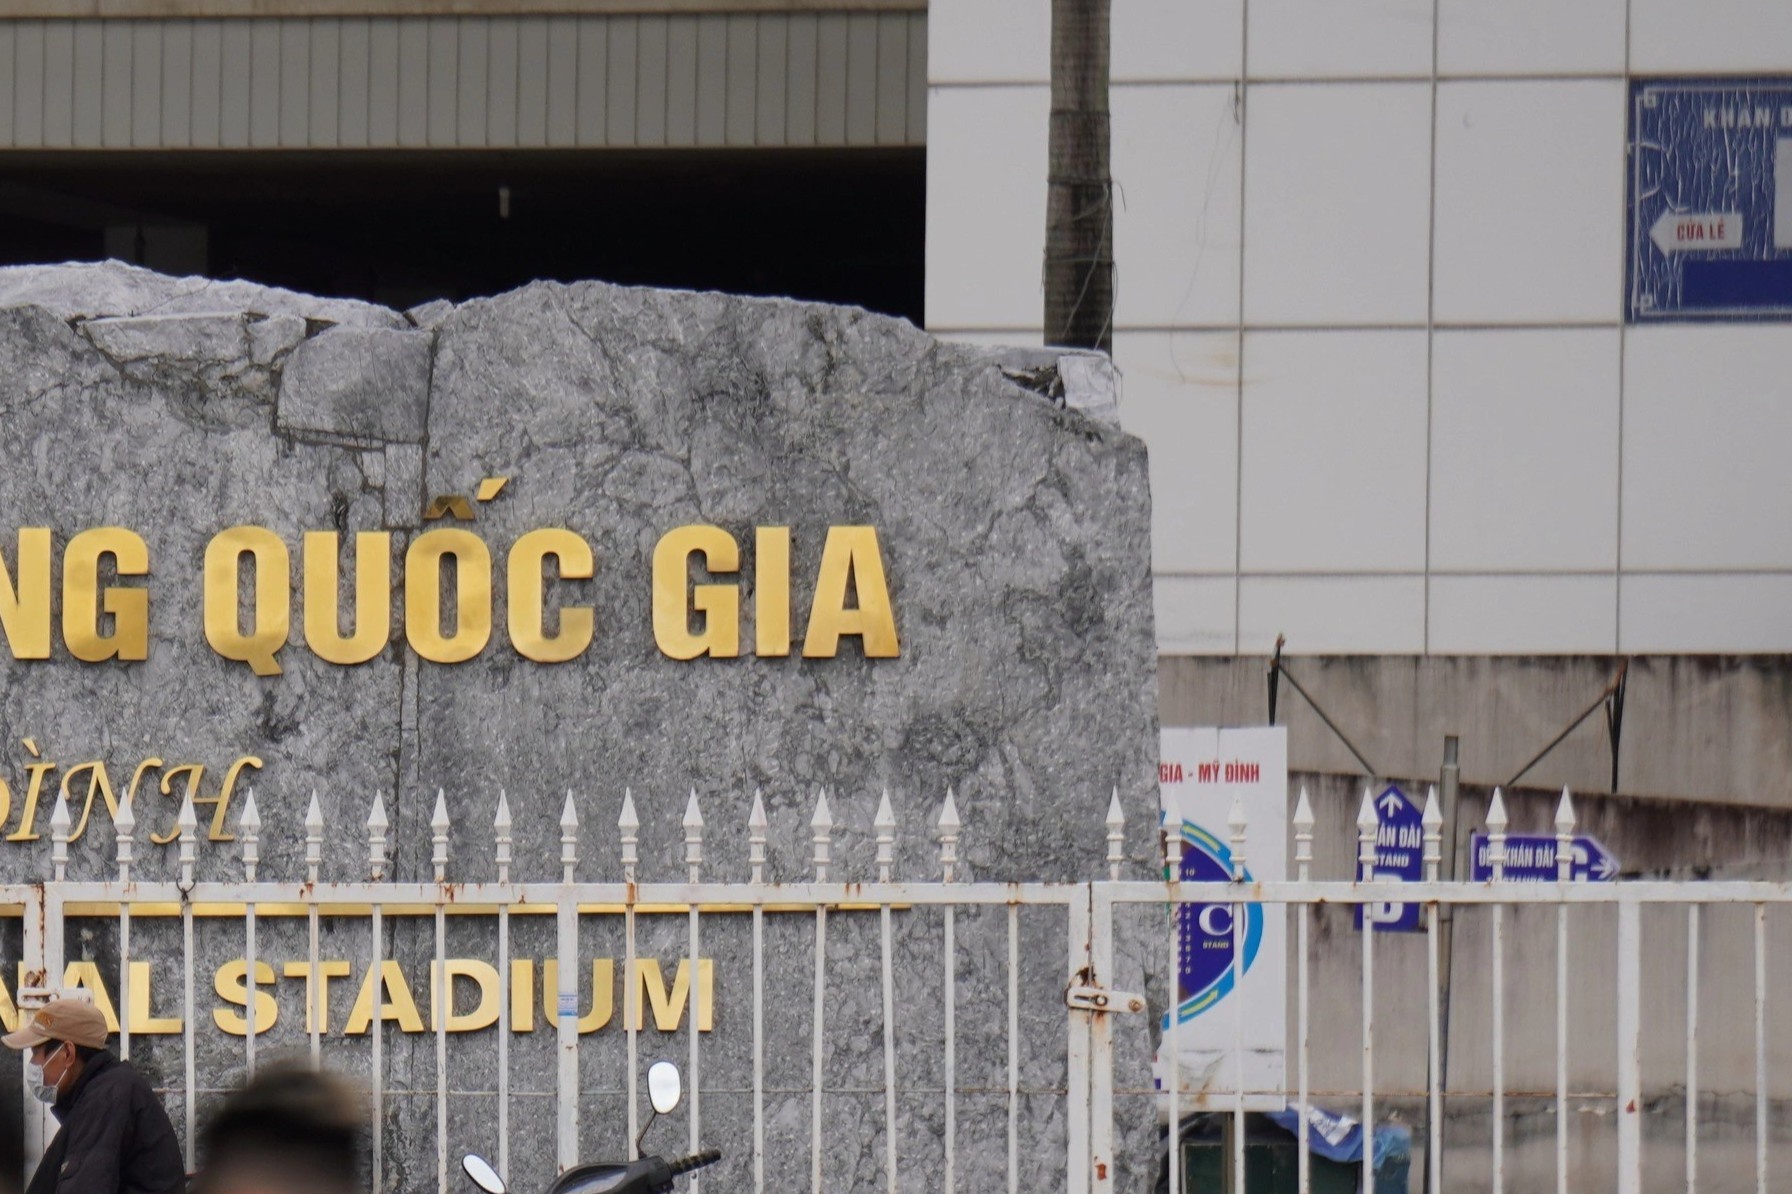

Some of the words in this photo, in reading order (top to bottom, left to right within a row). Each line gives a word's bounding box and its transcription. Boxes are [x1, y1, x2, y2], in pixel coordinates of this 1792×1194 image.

[204, 477, 595, 677] QUỐC
[651, 524, 901, 660] GIA
[1198, 904, 1234, 937] C
[212, 957, 714, 1035] STADIUM
